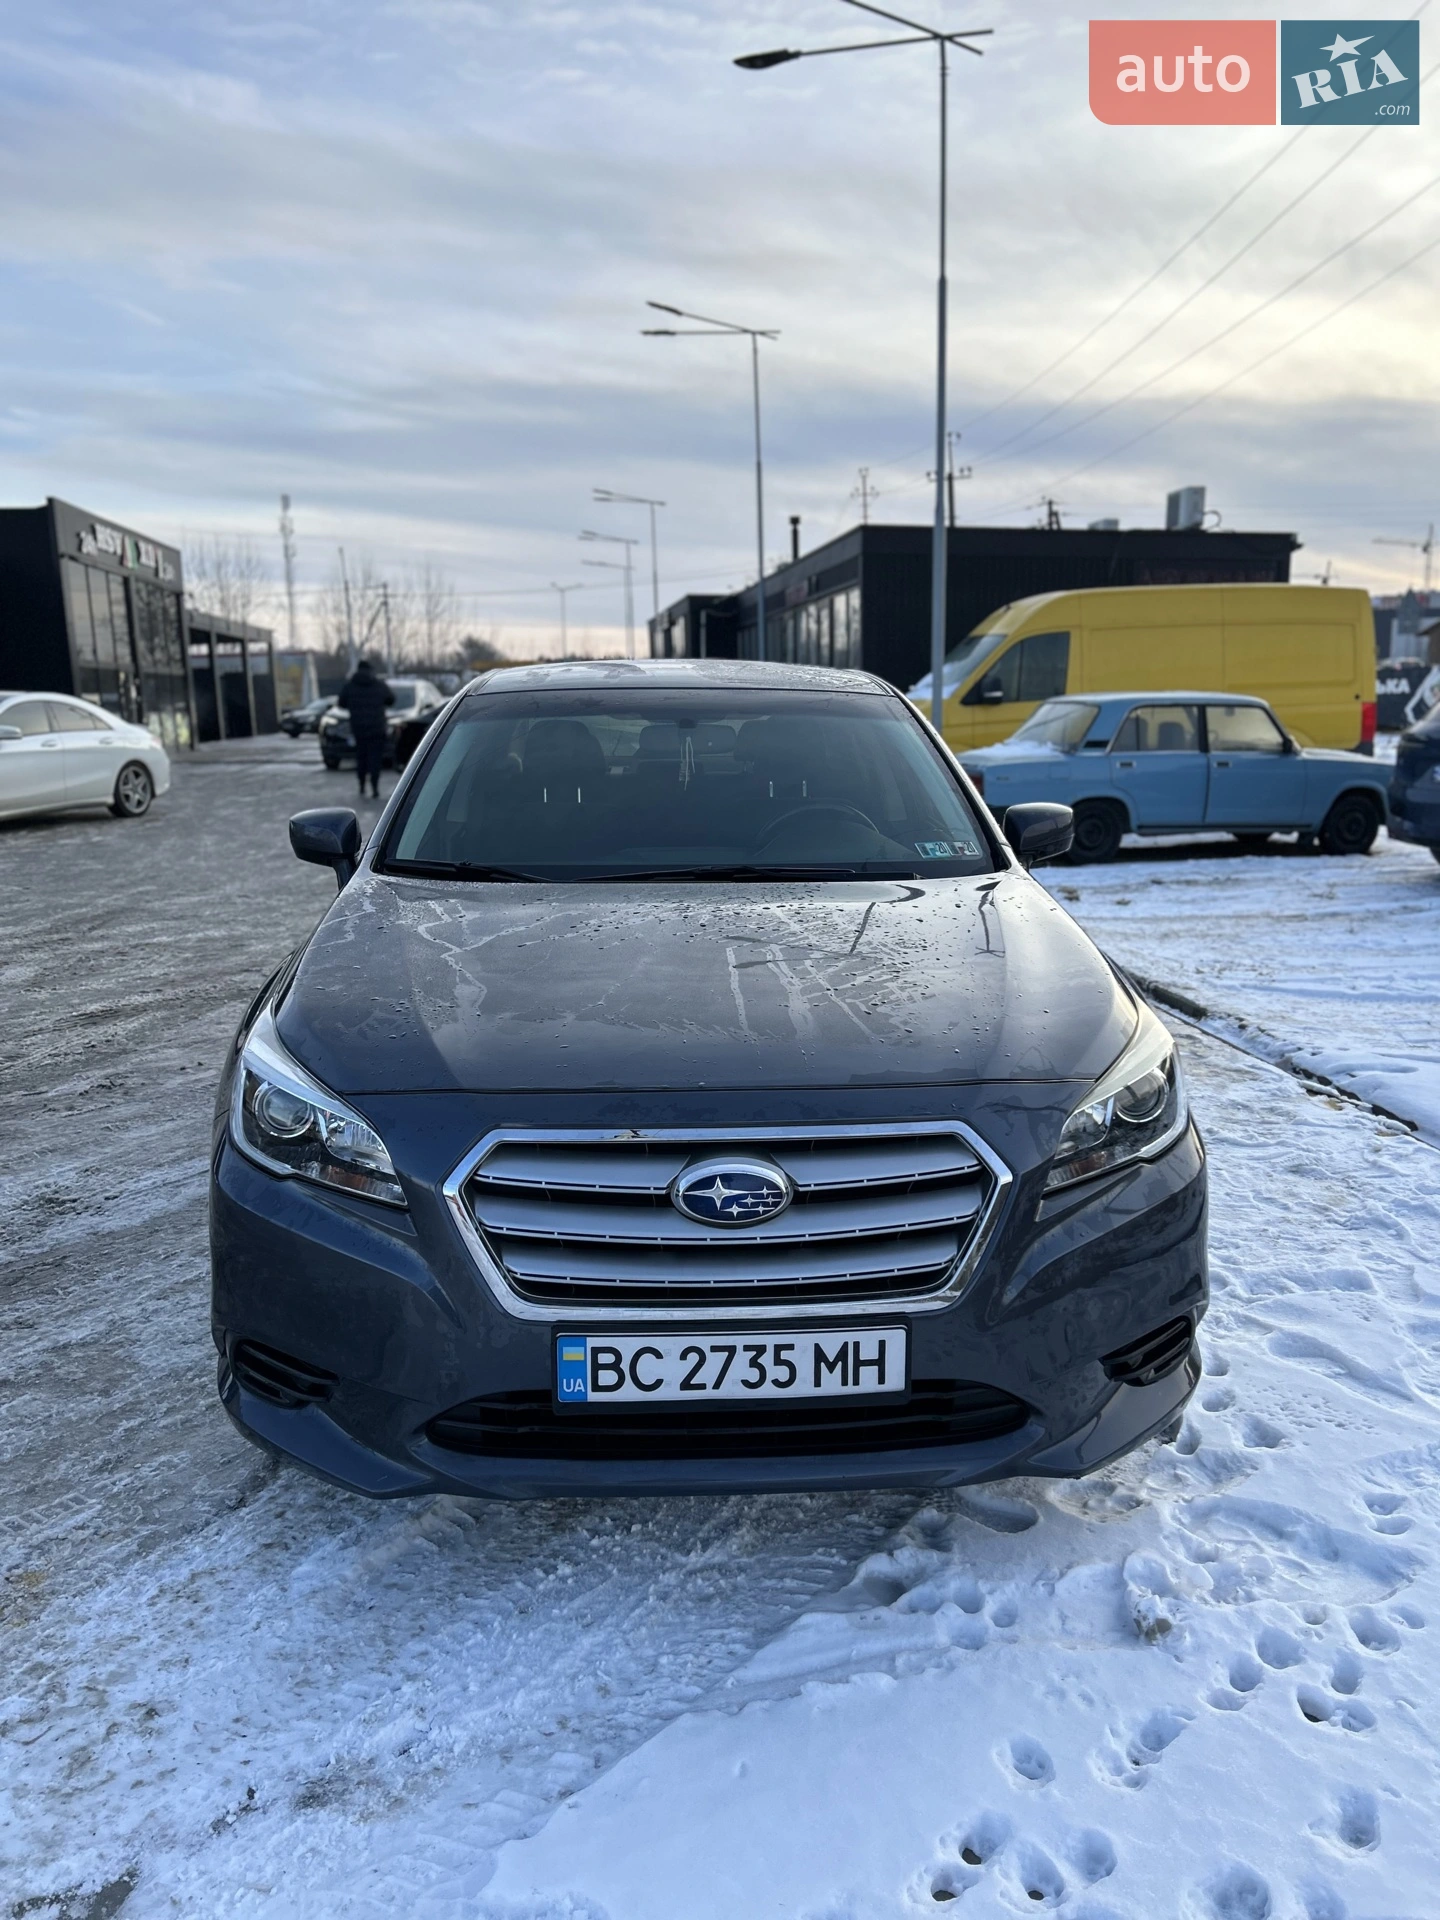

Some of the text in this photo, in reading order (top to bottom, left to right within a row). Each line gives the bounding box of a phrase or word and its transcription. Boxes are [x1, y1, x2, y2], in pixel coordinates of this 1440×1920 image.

[590, 1339, 887, 1393] BC 2735 MH
[563, 1378, 586, 1393] UA
